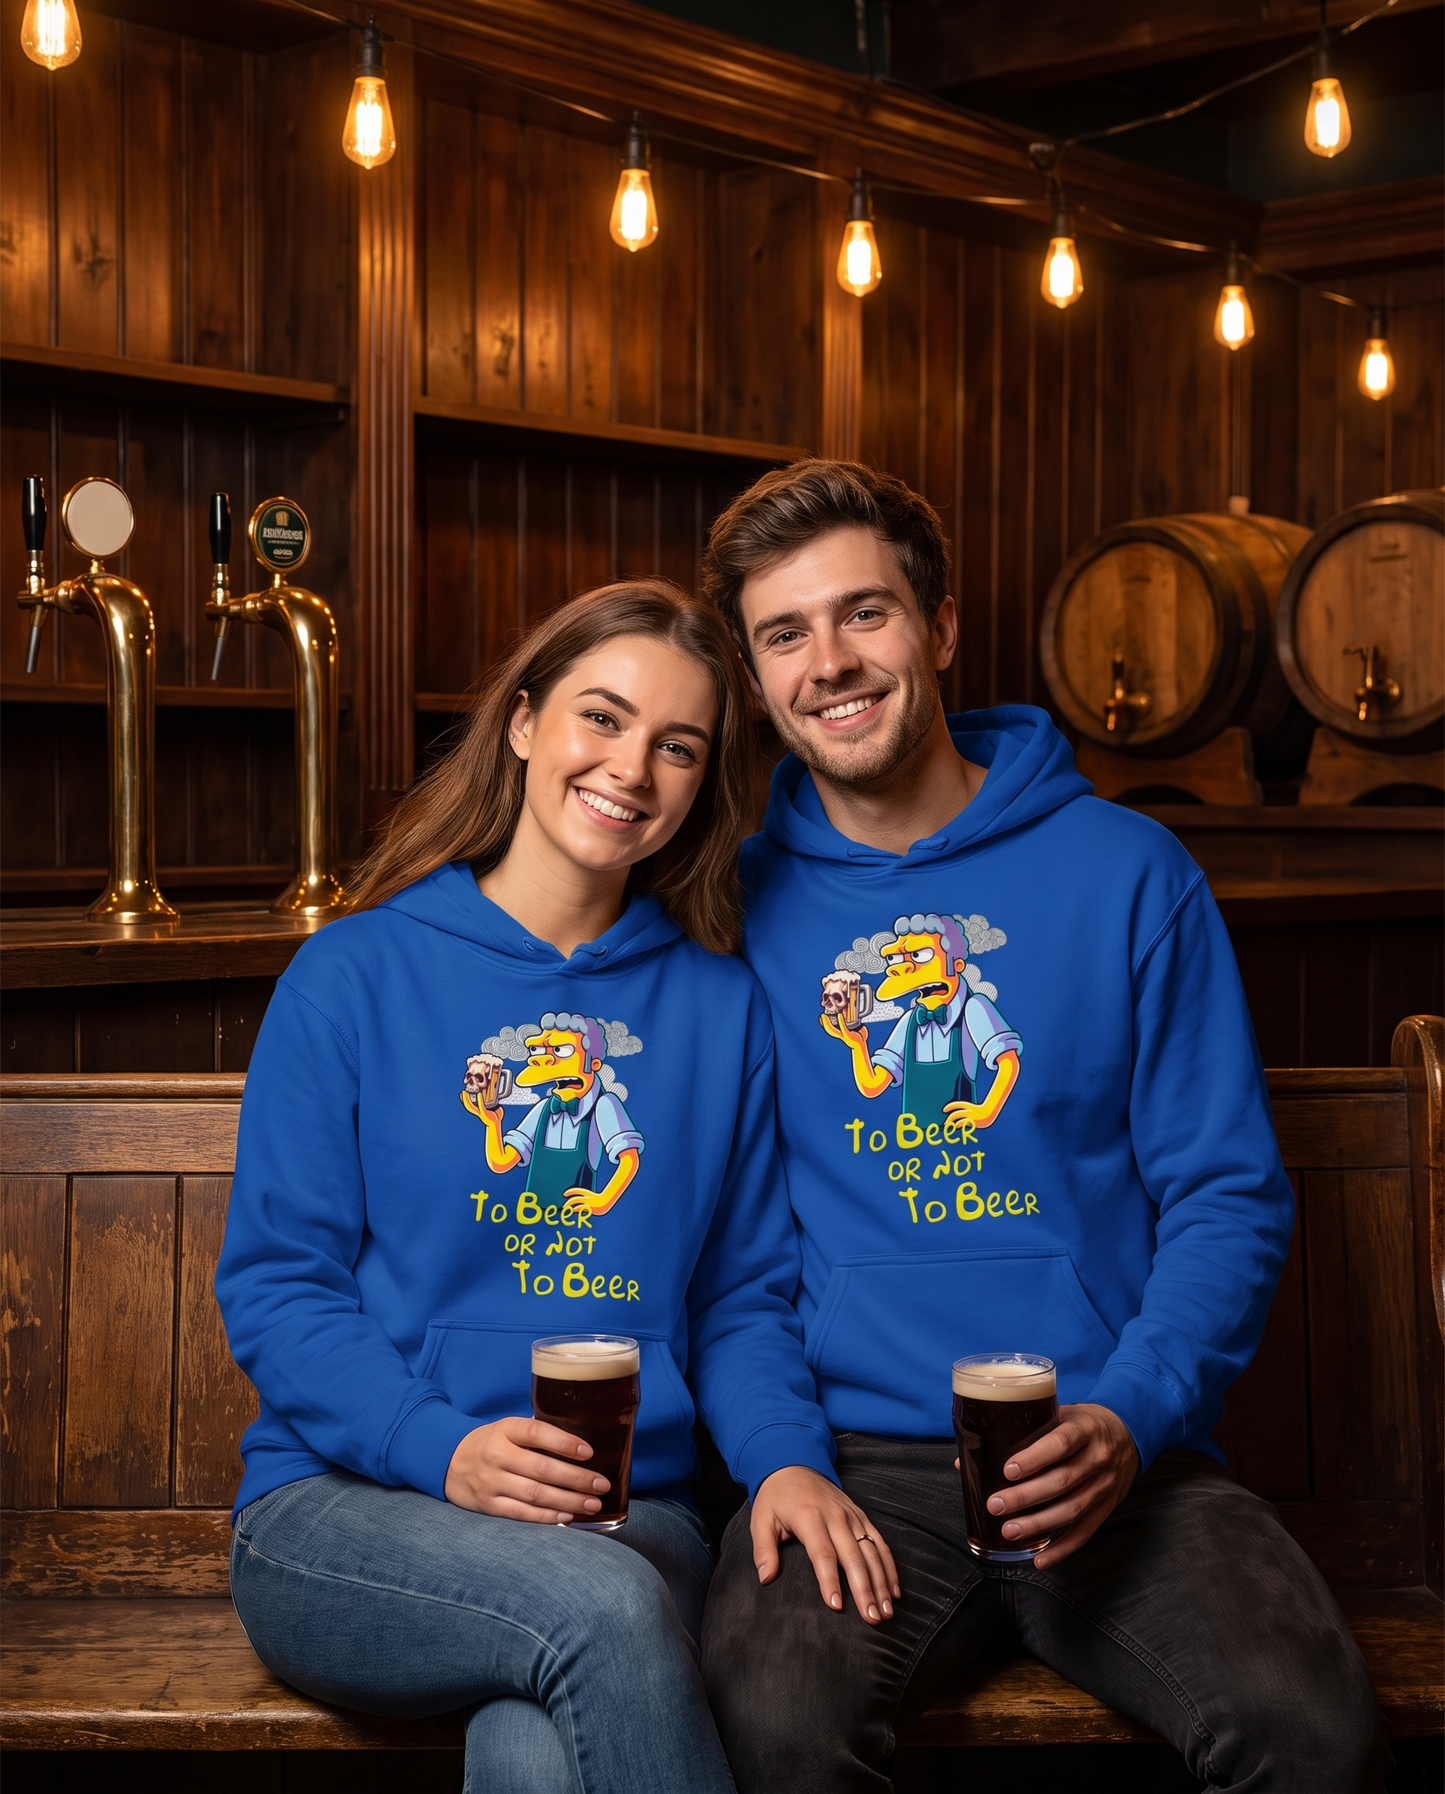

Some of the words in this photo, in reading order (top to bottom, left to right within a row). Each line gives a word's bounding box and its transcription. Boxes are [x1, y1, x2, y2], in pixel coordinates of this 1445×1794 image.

[845, 1118, 887, 1153] To
[888, 1157, 921, 1182] OR
[933, 1150, 985, 1179] NOT
[470, 1190, 508, 1223] To
[899, 1187, 947, 1223] To
[504, 1233, 536, 1256] OR
[545, 1231, 596, 1256] NOT
[512, 1260, 554, 1295] To
